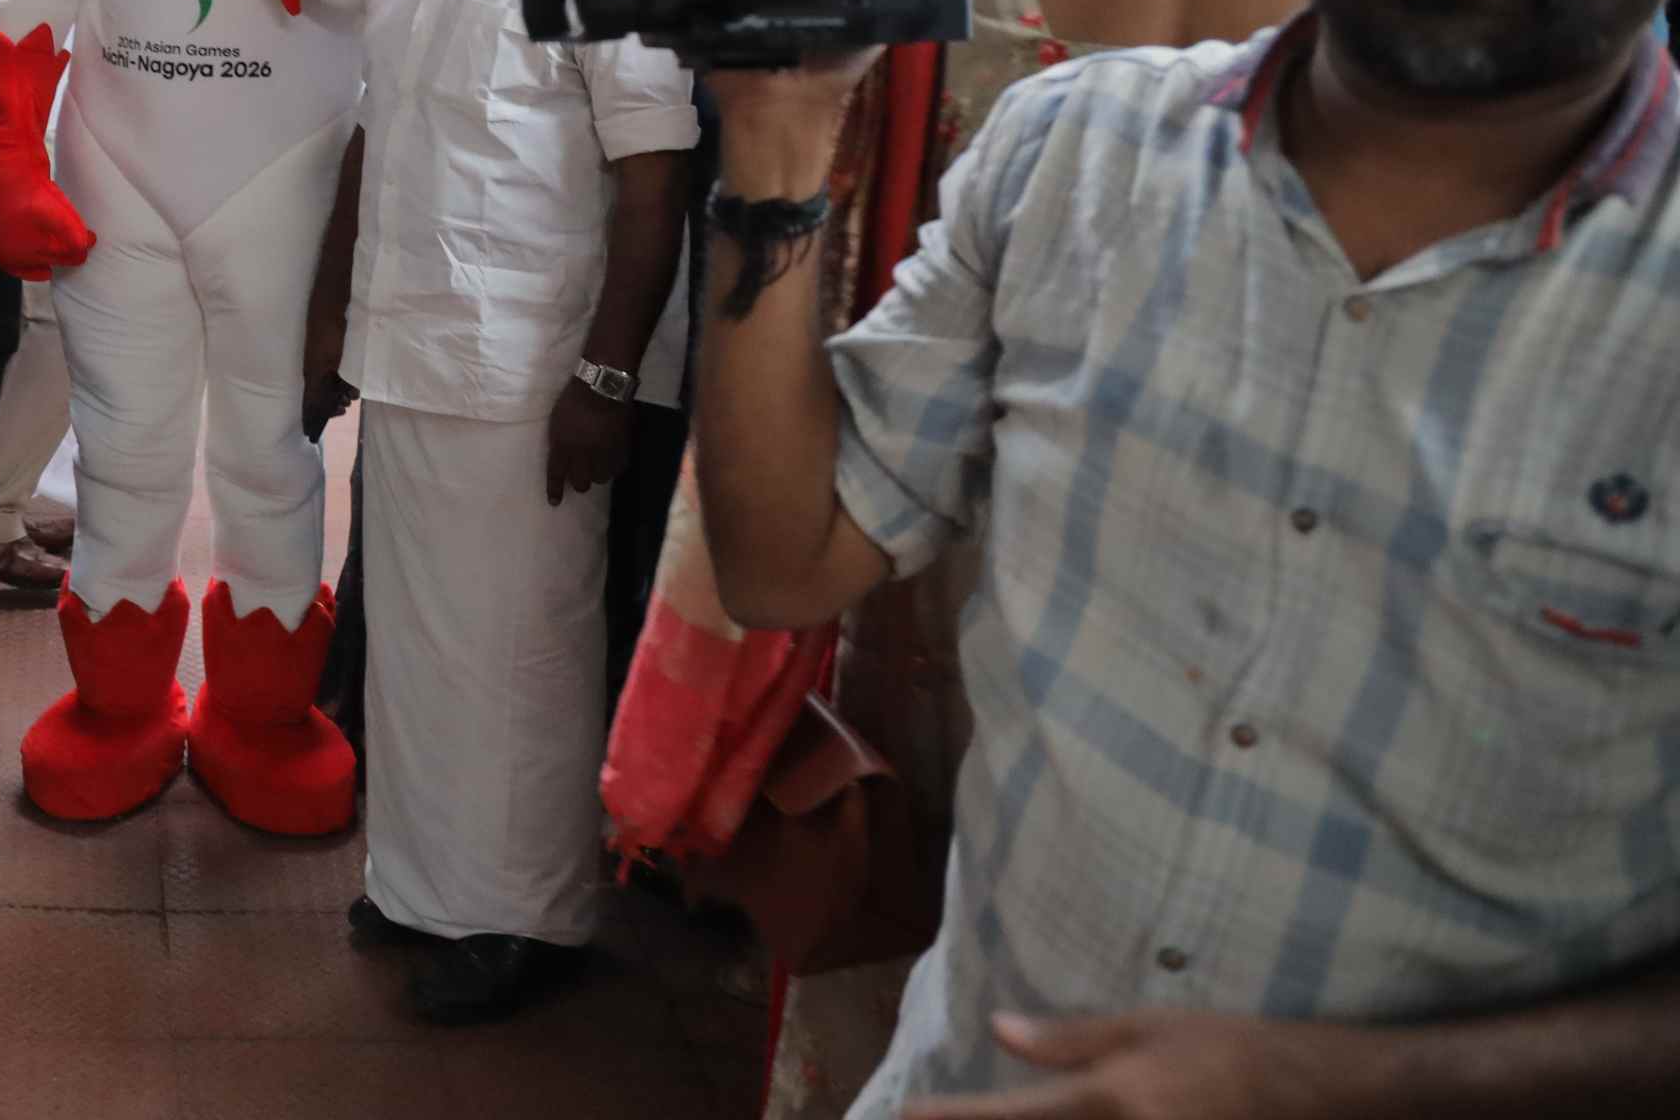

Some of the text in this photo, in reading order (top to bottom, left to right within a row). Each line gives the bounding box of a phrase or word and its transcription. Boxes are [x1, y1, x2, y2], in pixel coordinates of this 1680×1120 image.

[144, 41, 180, 54] Asian
[186, 43, 240, 57] Games
[220, 61, 272, 78] 2026
